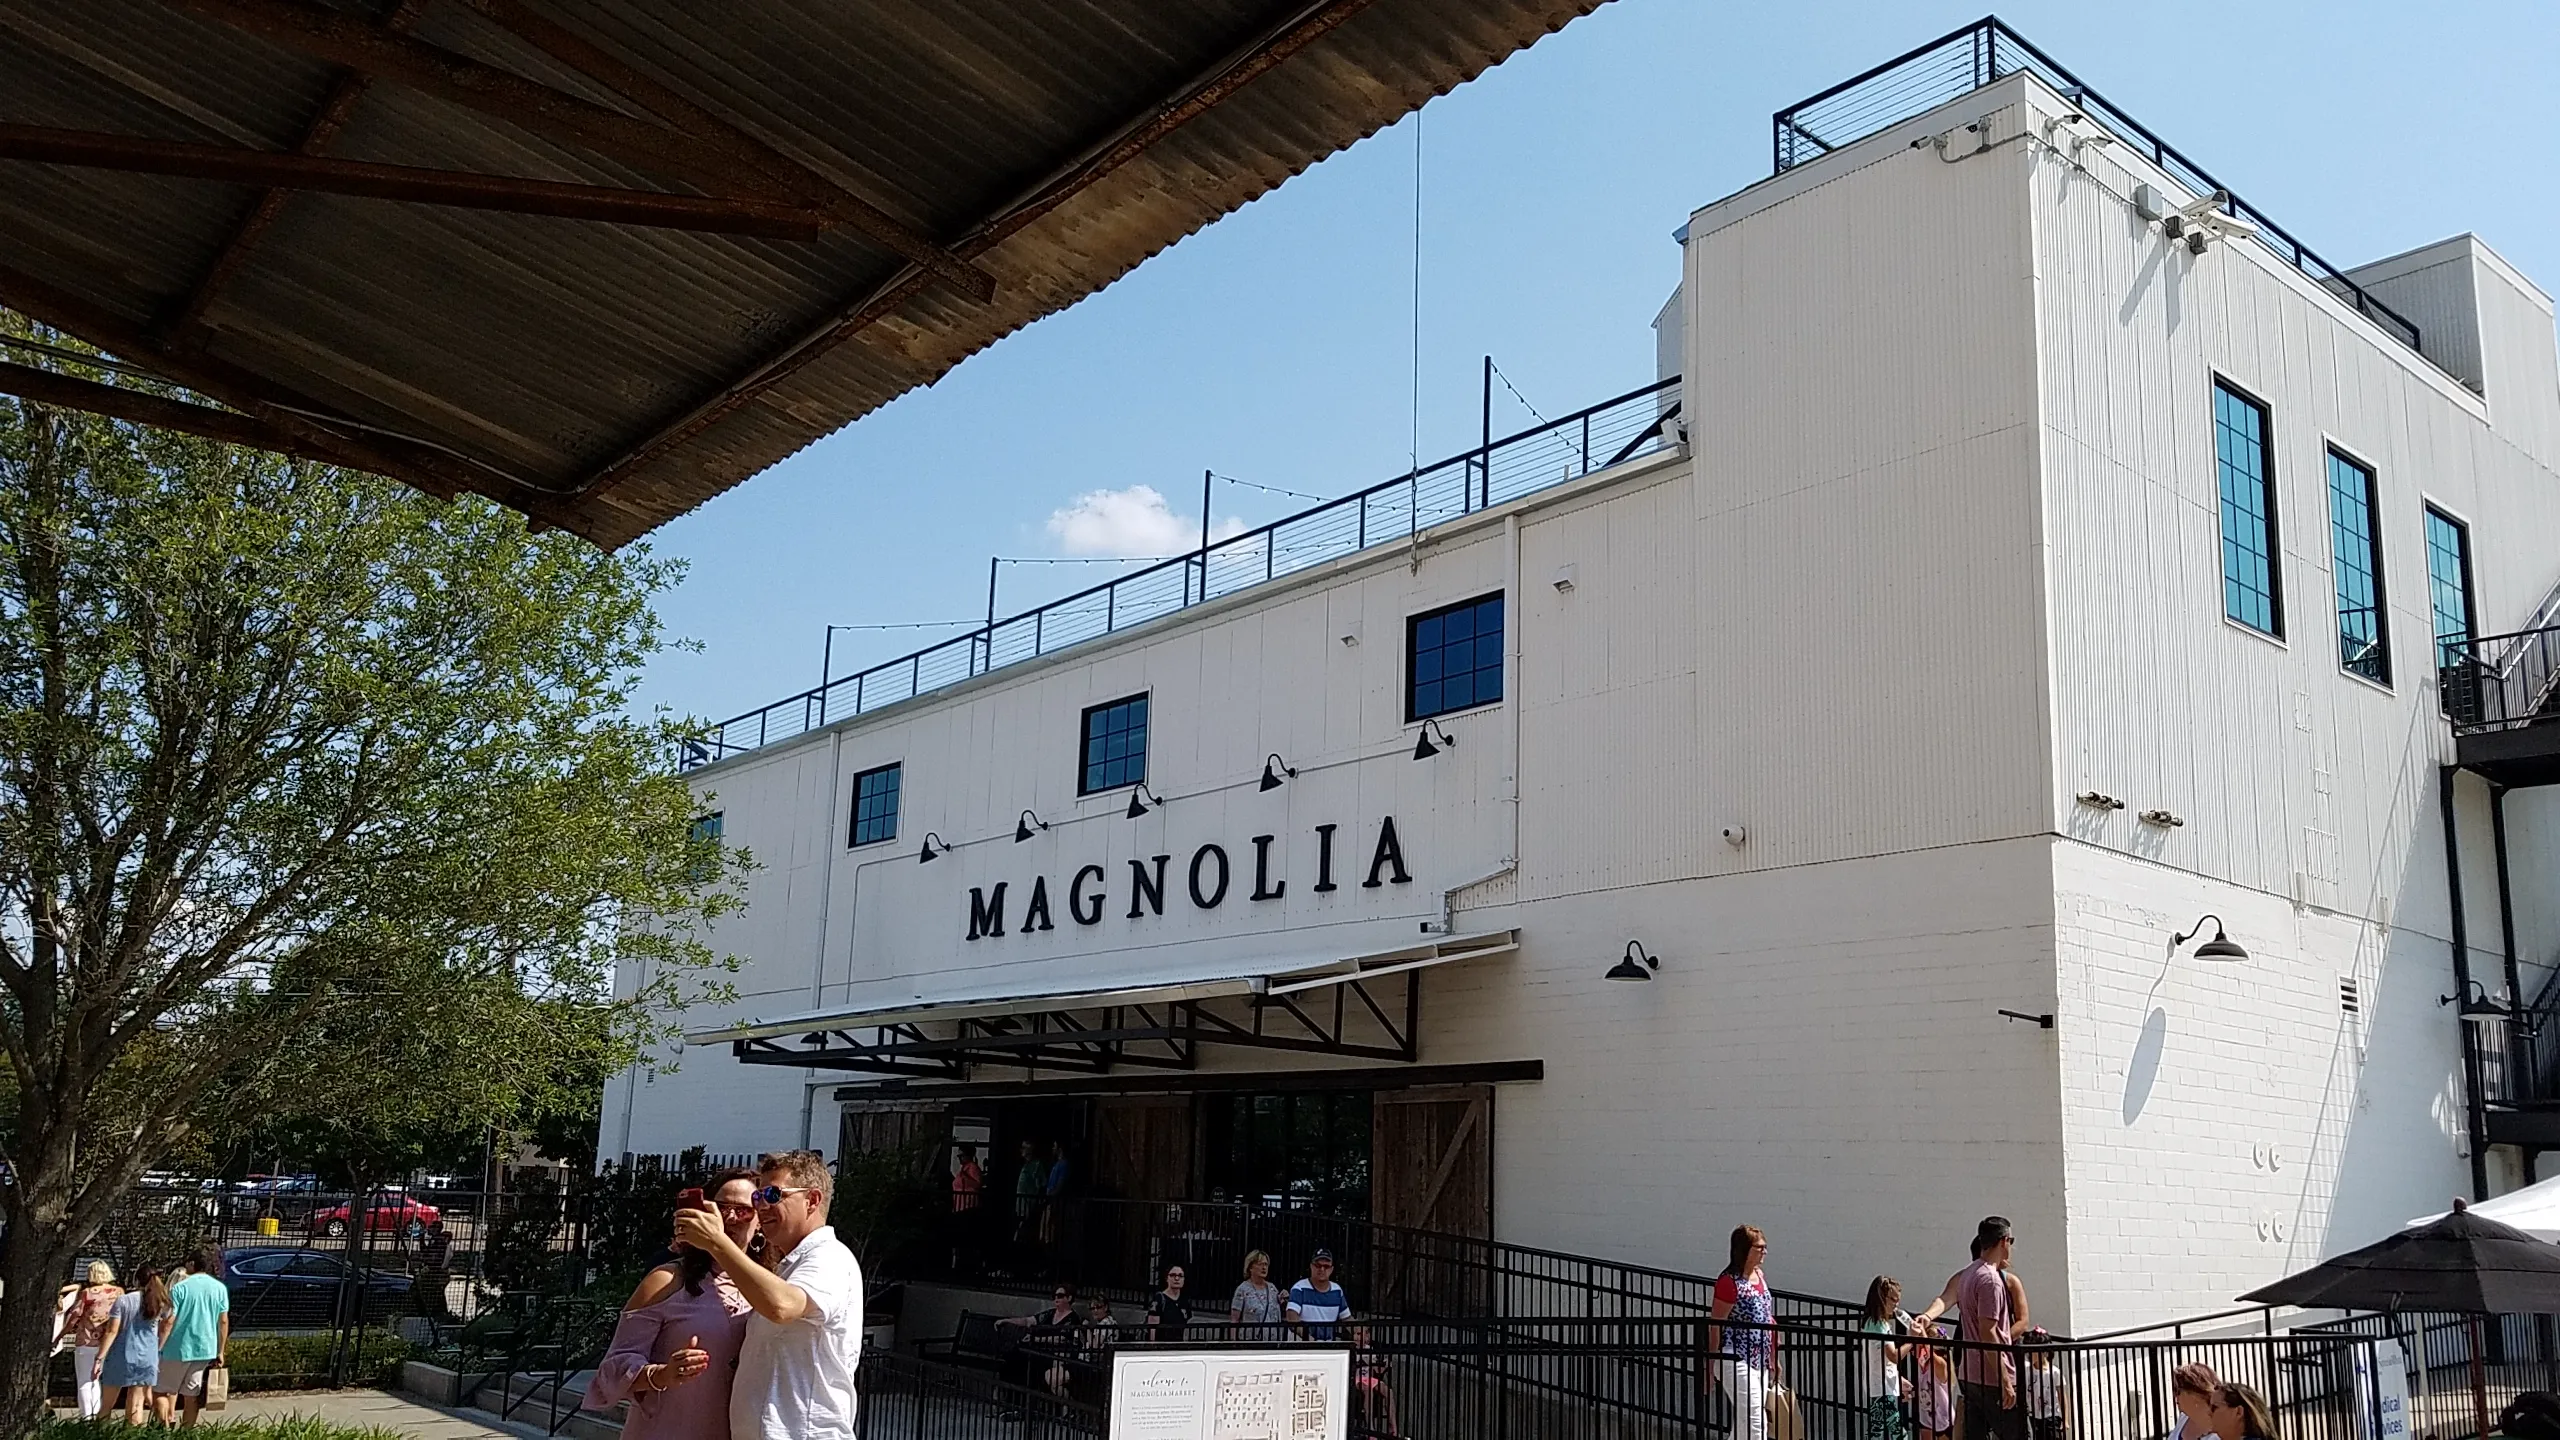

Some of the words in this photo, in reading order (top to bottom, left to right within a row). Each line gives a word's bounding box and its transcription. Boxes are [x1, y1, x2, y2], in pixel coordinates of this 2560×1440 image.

[965, 815, 1413, 941] MAGNOLIA
[1142, 1370, 1175, 1388] welcome
[1181, 1377, 1188, 1386] to
[1168, 1389, 1196, 1397] MARKET
